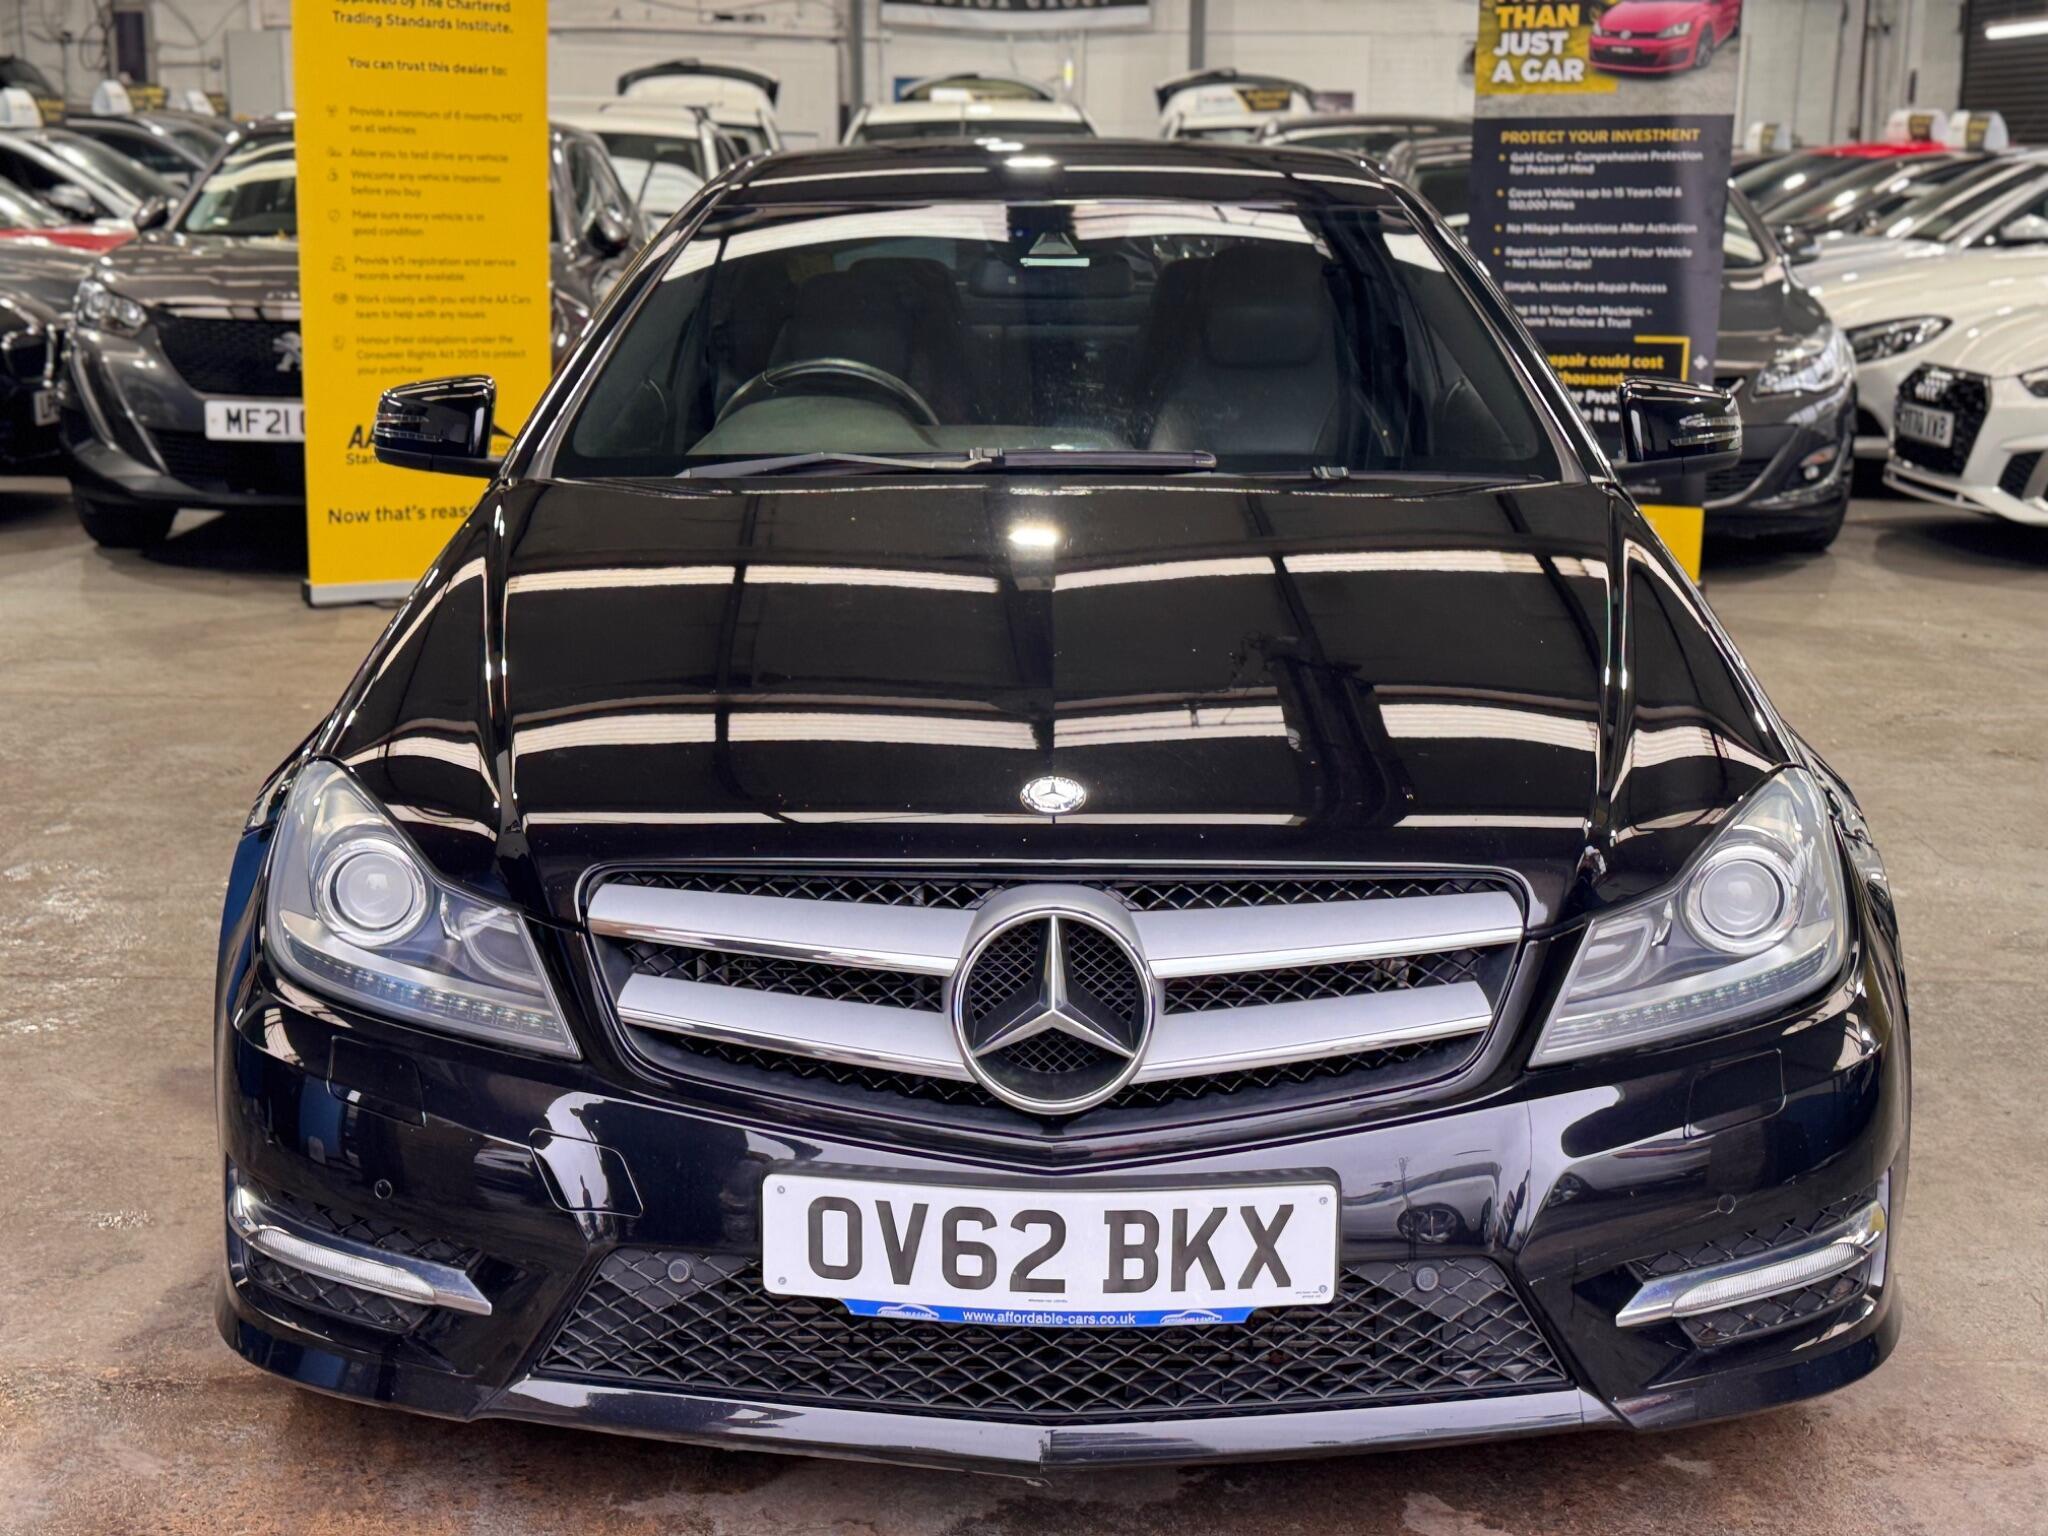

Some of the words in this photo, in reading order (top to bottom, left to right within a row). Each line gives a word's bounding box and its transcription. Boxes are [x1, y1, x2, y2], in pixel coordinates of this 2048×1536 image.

[447, 0, 511, 12] Chartered
[332, 10, 382, 28] Trading
[386, 13, 452, 30] Standards
[456, 18, 514, 33] Institute.
[1495, 4, 1580, 29] THAN
[1494, 31, 1569, 56] JUST
[347, 56, 370, 69] You
[372, 60, 394, 70] can
[396, 59, 425, 71] trust
[428, 60, 450, 73] this
[452, 62, 488, 75] dealer
[1491, 59, 1516, 83] A
[1521, 58, 1585, 83] CAR
[348, 105, 385, 117] Provide
[377, 123, 416, 135] vehicles
[1500, 131, 1565, 144] PROTECT
[1568, 130, 1610, 144] YOUR
[1611, 128, 1701, 143] INVESTMENT
[475, 152, 509, 162] vehicle
[1536, 151, 1565, 163] Cover
[1574, 151, 1649, 164] Comprehensive
[1650, 150, 1704, 162] Protection
[1526, 163, 1556, 175] Peace
[1570, 163, 1595, 175] Mind
[417, 171, 450, 182] vehicle
[1508, 186, 1543, 199] Covers
[1543, 187, 1585, 199] Vehicles
[1625, 186, 1653, 198] Years
[1654, 186, 1673, 198] Old
[1549, 199, 1575, 211] Miles
[1506, 222, 1522, 234] No
[1522, 222, 1560, 235] Mileage
[1561, 222, 1619, 234] Restrictions
[1619, 222, 1645, 234] After
[1646, 222, 1698, 234] Activation
[1504, 246, 1538, 258] Repair
[1570, 246, 1589, 257] The
[1590, 246, 1618, 258] Value
[1618, 246, 1630, 258] of
[1631, 246, 1654, 258] Your
[1655, 246, 1693, 258] Vehicle
[353, 255, 389, 266] Provide
[1528, 258, 1563, 269] Hidden
[1597, 281, 1629, 294] Repair
[1630, 281, 1668, 293] Process
[1551, 304, 1575, 316] Your
[1576, 304, 1599, 316] Own
[1600, 304, 1645, 317] Mechanic
[1547, 316, 1567, 327] You
[1568, 316, 1596, 327] Know
[1607, 317, 1632, 328] Trust
[1548, 352, 1588, 369] epair
[1589, 353, 1630, 369] could
[1631, 354, 1664, 370] cost
[226, 407, 290, 435] MF21
[328, 508, 371, 524] Now
[376, 504, 426, 522] that's
[806, 1195, 1067, 1294] OV62
[1102, 1204, 1295, 1294] BKX
[963, 1311, 1136, 1325] www.affordable-cars.co.uk
